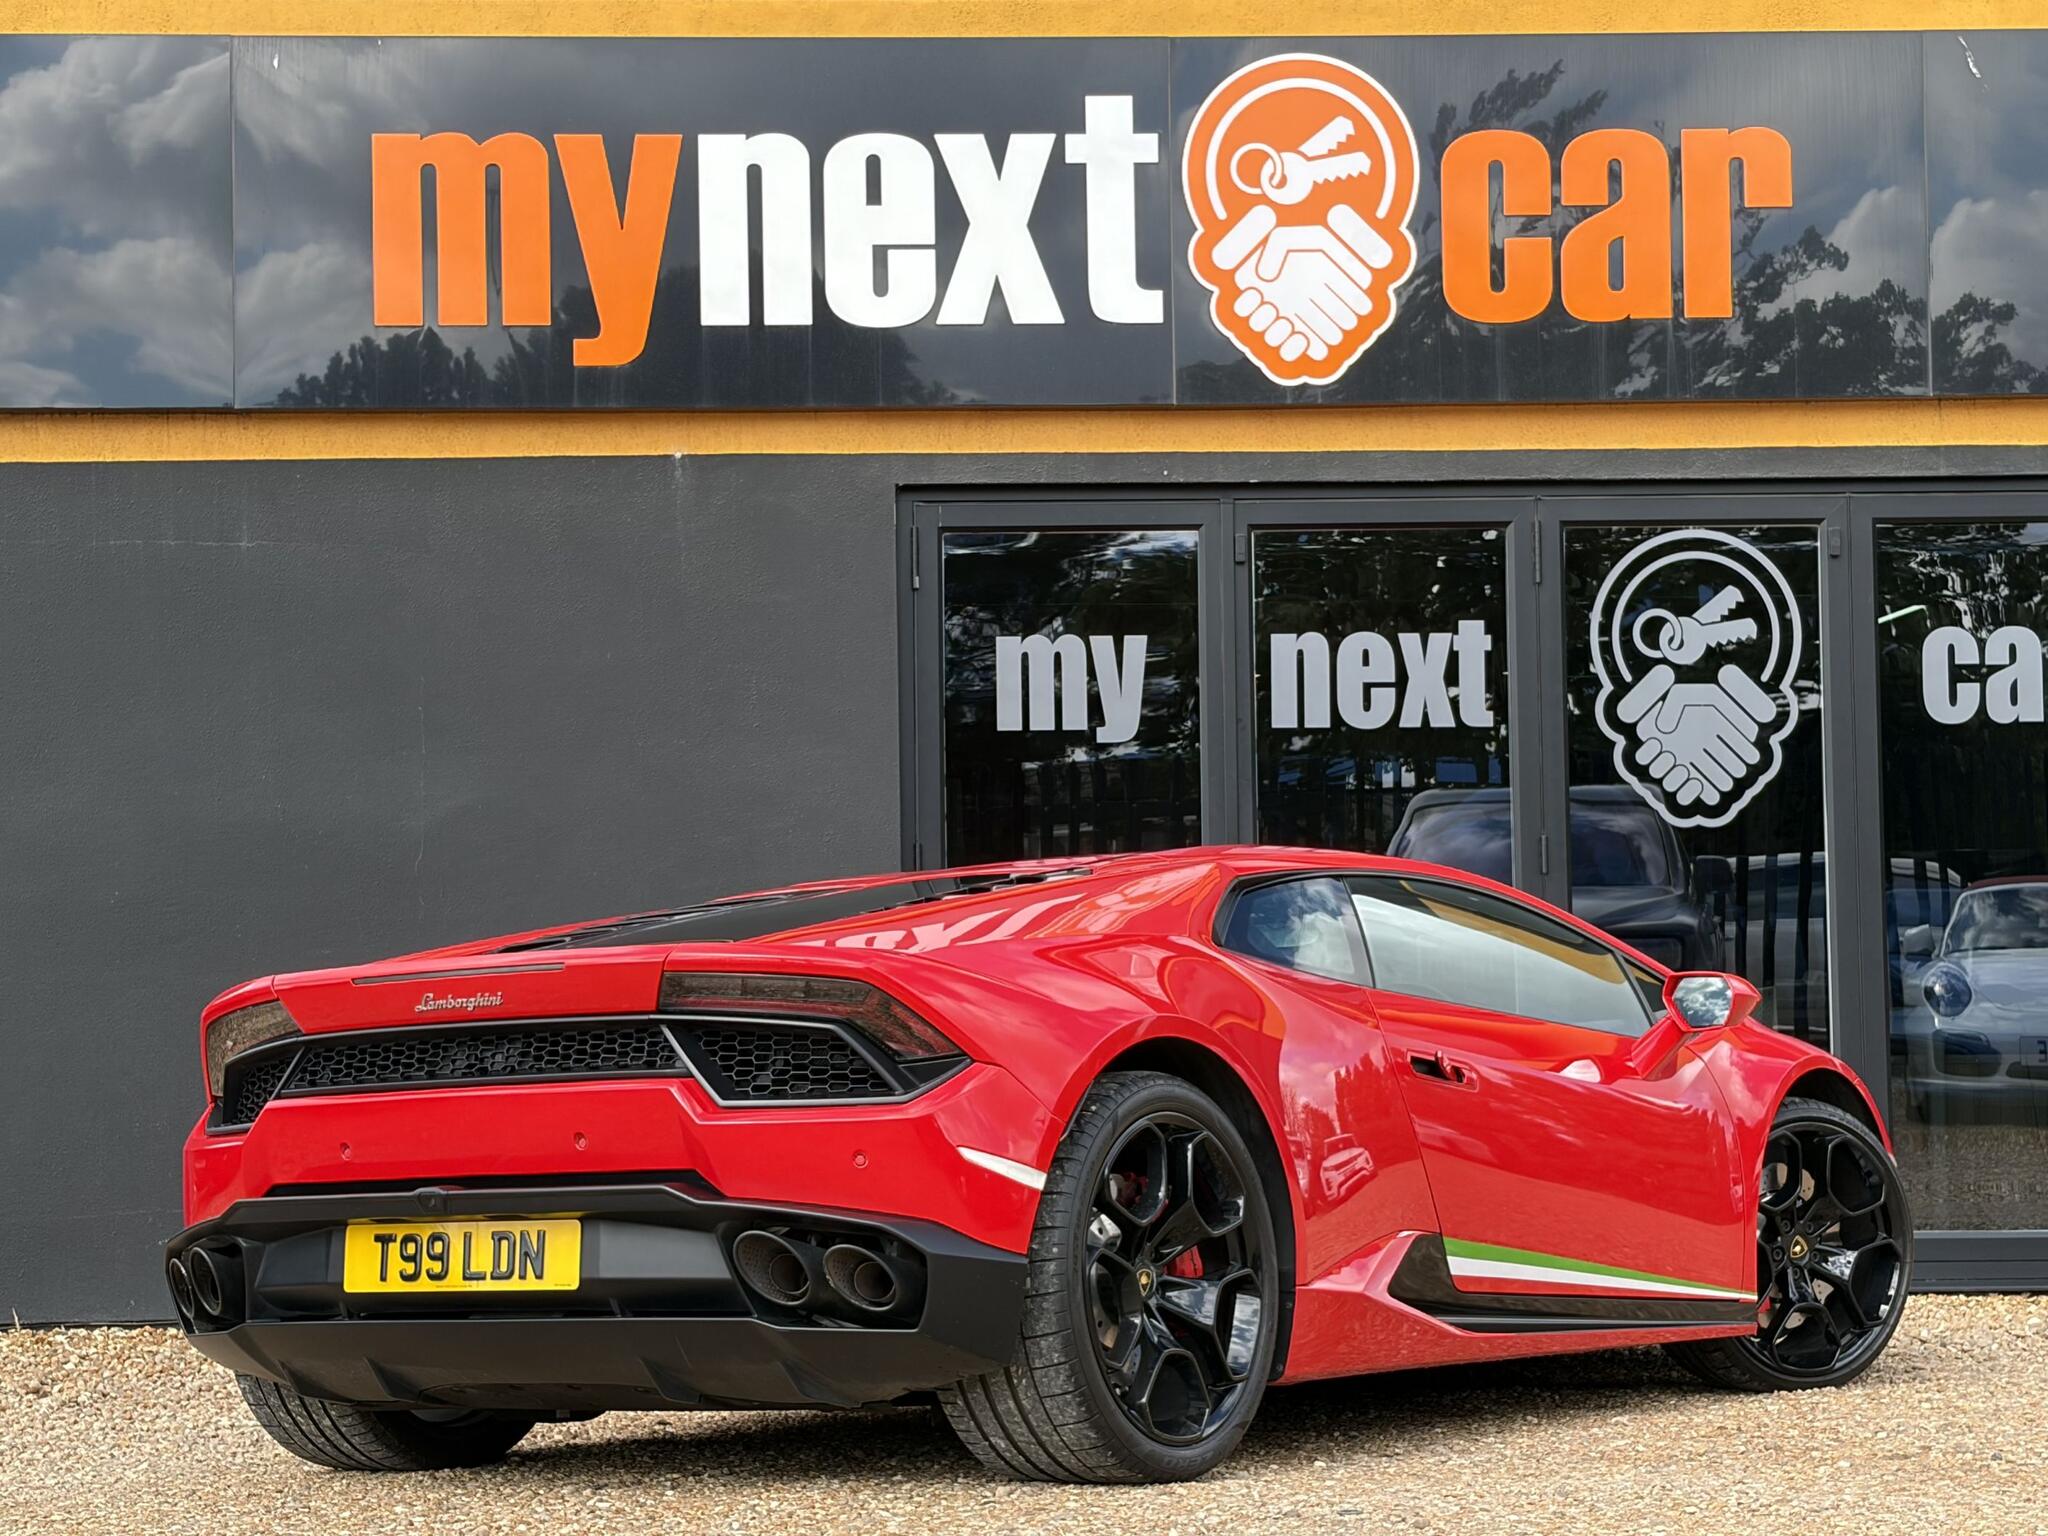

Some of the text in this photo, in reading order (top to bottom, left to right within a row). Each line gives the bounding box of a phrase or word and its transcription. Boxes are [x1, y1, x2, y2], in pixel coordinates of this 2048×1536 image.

[1441, 126, 1793, 324] car
[995, 633, 1148, 744] my
[1270, 619, 1494, 730] next
[414, 991, 504, 1012] Lamborghini
[373, 1229, 546, 1282] T99 LDN
